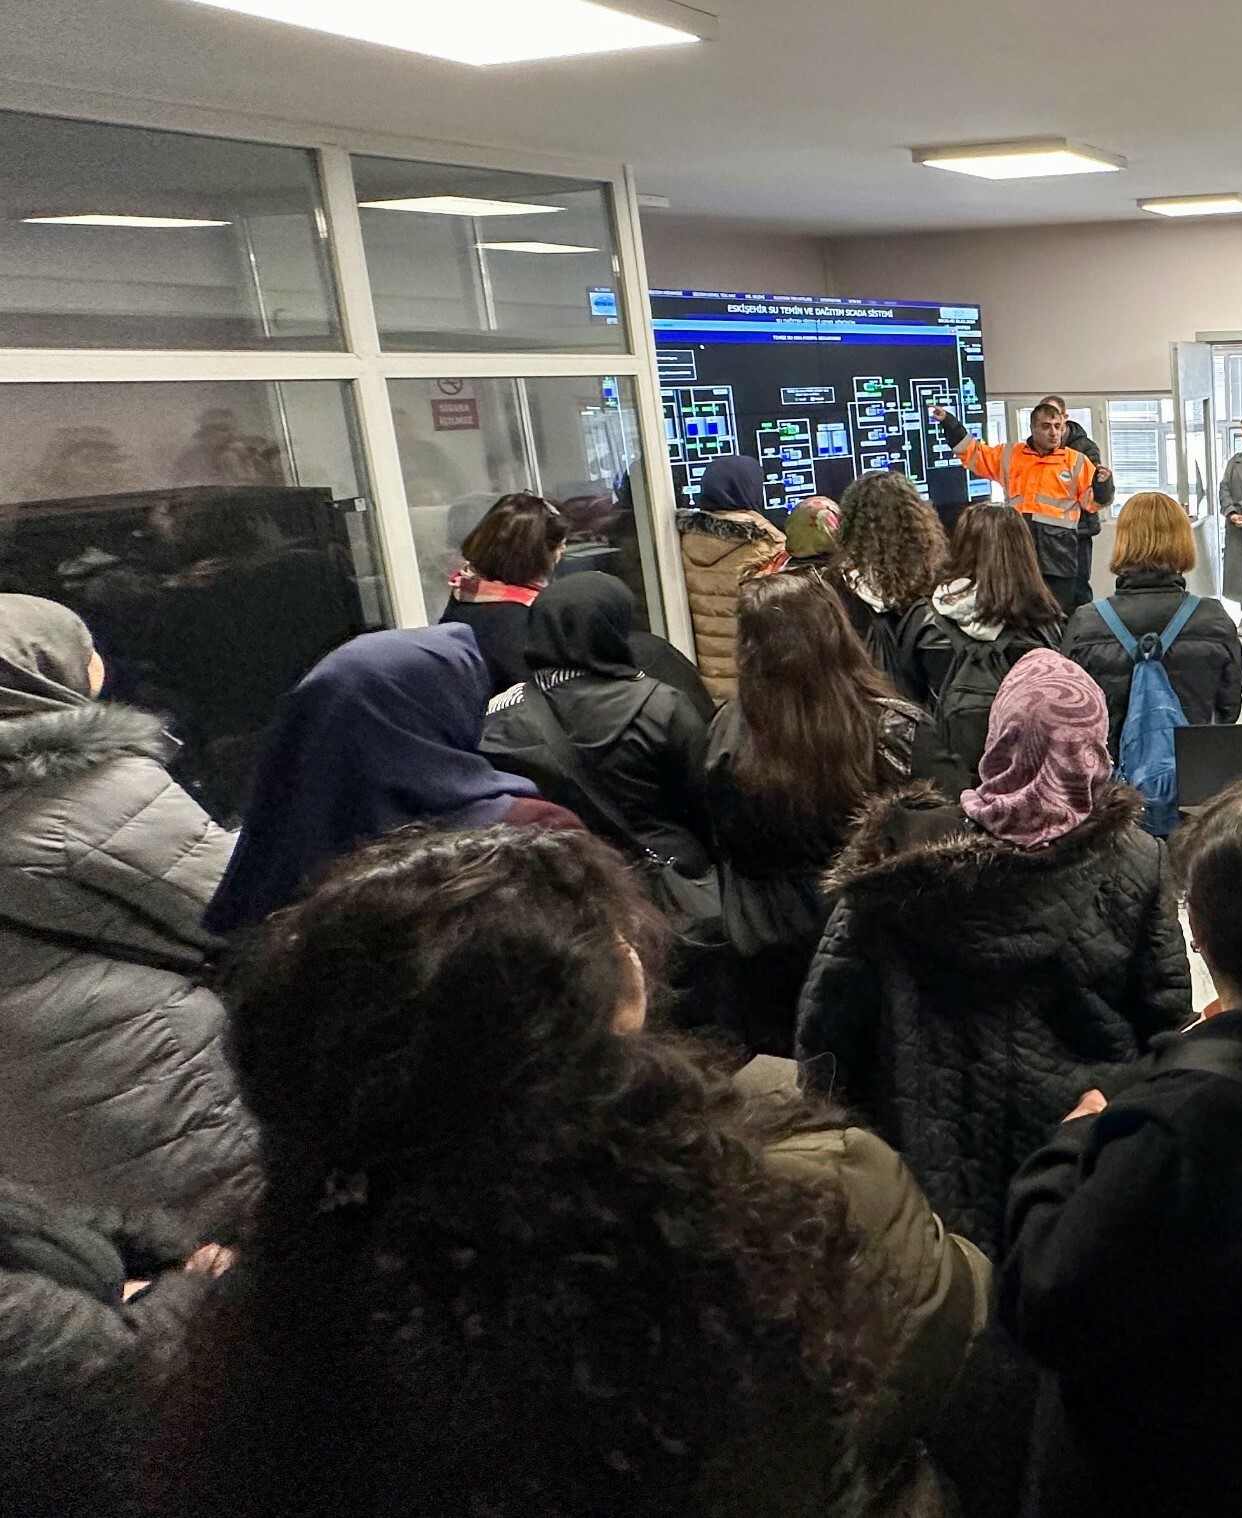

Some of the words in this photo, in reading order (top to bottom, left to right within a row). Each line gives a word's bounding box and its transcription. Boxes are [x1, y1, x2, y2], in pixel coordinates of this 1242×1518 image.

[727, 304, 767, 314] ESKİŞEHİR
[780, 305, 804, 315] TEMİN
[804, 307, 814, 316] VE
[814, 306, 845, 317] DAĞITIM
[845, 309, 868, 318] SCADA
[867, 308, 893, 318] SİSTEMİ
